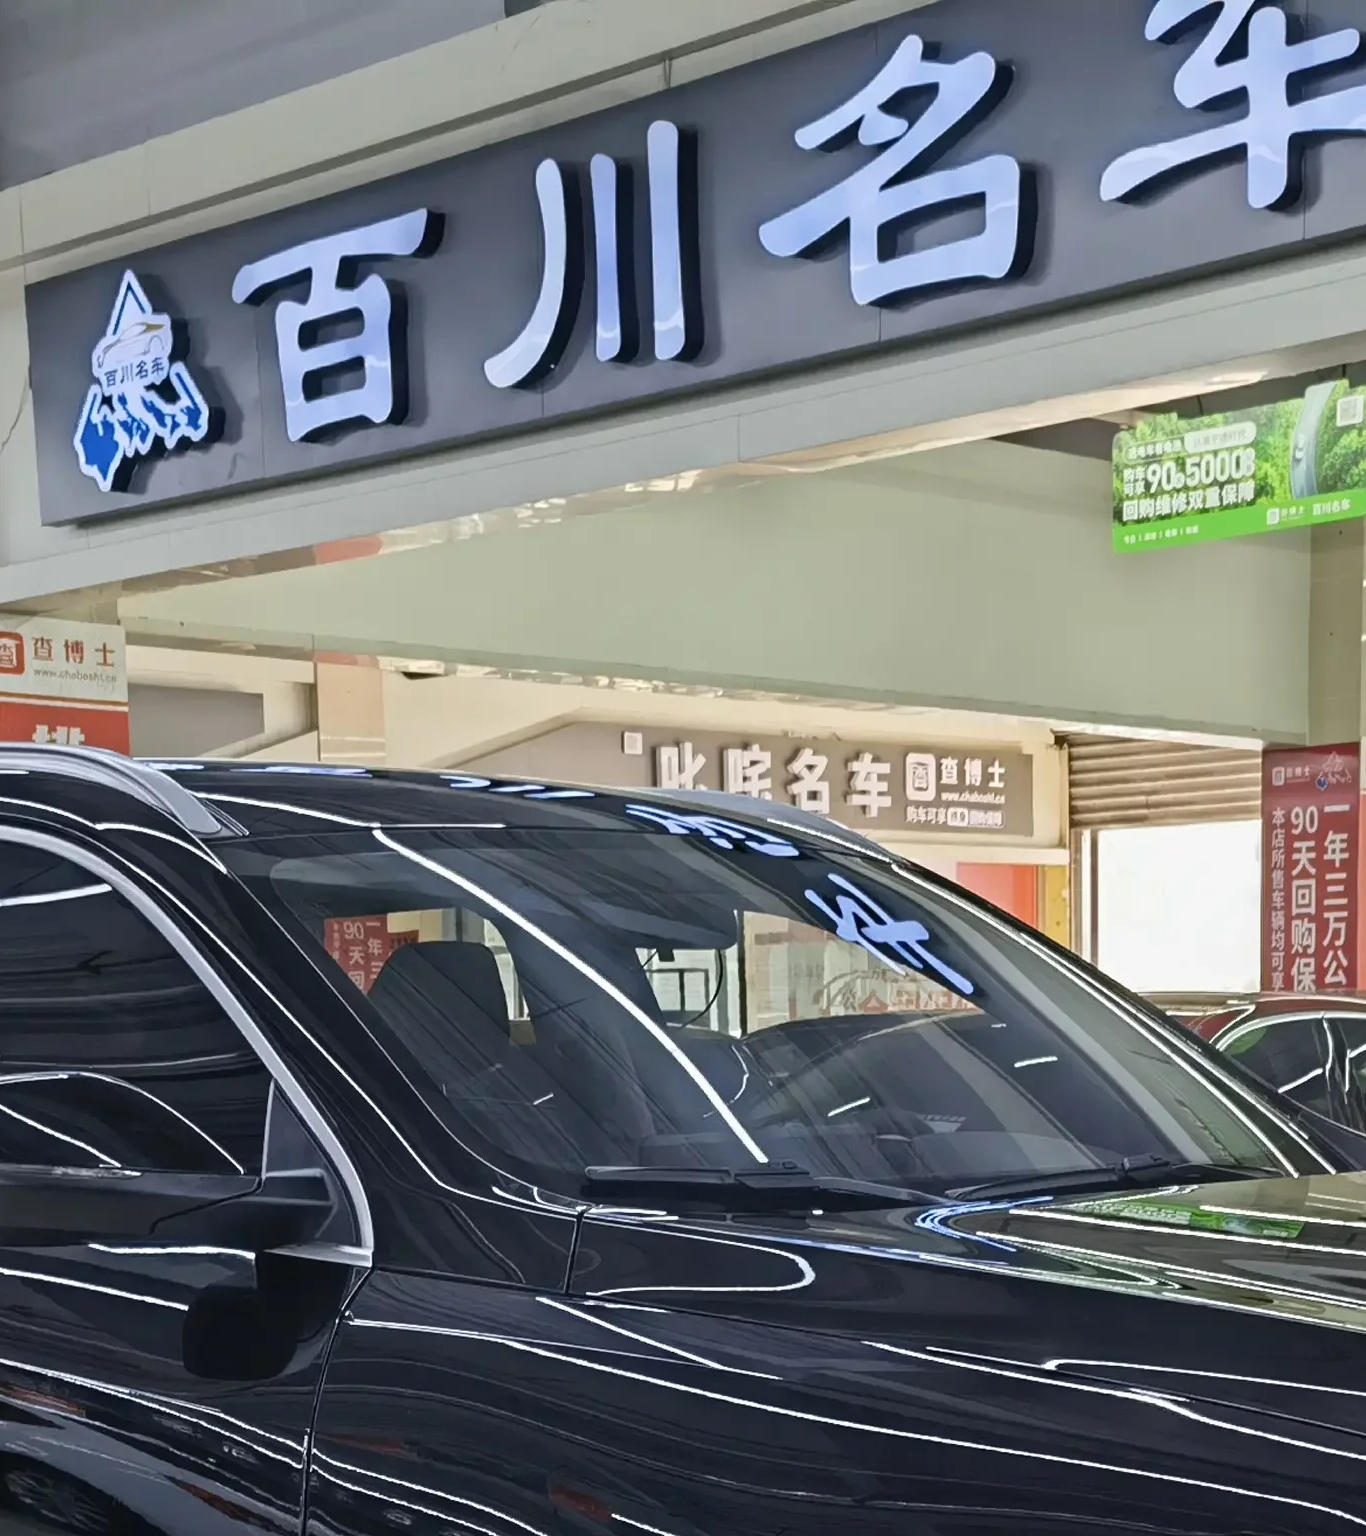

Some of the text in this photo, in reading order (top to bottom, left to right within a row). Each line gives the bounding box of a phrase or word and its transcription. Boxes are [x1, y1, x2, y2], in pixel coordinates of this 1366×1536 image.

[104, 356, 165, 388] 百川名车
[32, 636, 115, 668] 查博士
[939, 756, 1006, 789] 查博士
[1290, 806, 1319, 992] 90天回购保
